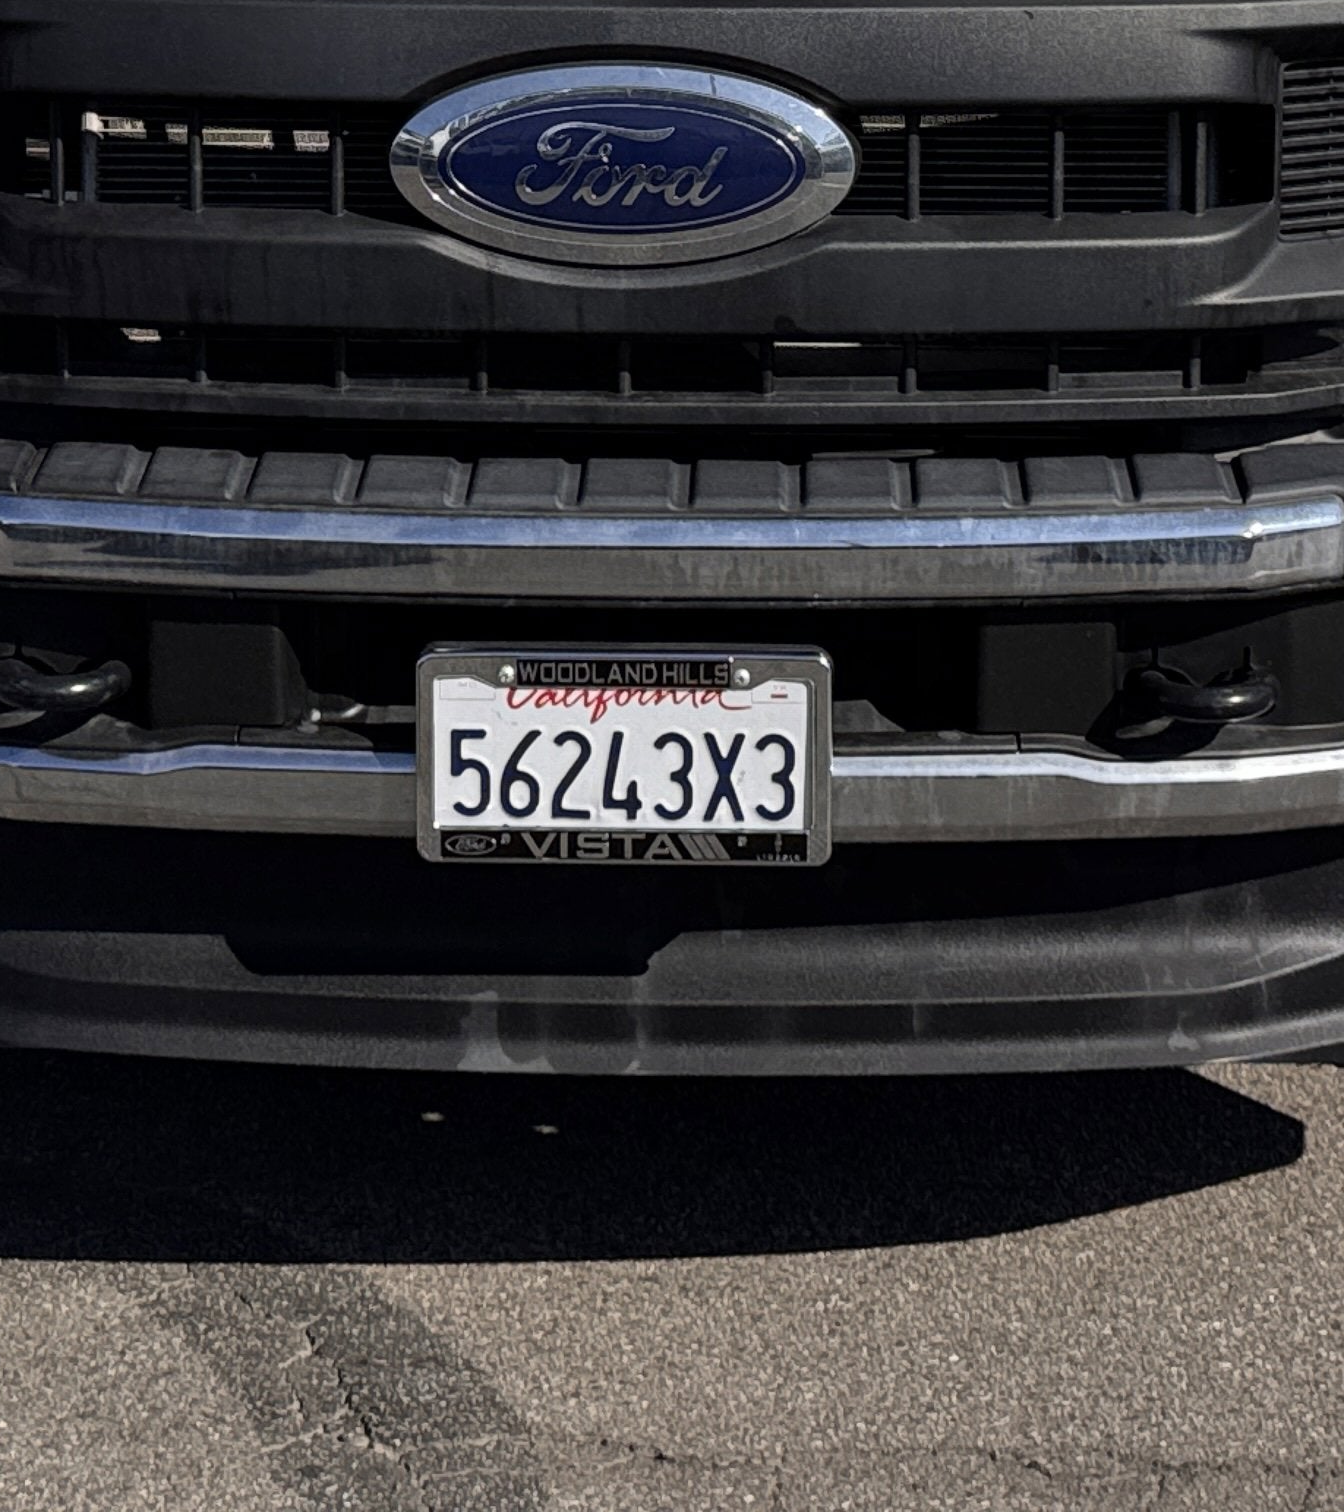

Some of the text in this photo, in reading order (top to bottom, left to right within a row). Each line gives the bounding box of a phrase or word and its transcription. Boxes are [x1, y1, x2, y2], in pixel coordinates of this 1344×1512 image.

[515, 120, 729, 208] Ford
[517, 661, 730, 686] WOODLAND HILLS
[449, 728, 797, 823] 56243X3
[520, 832, 684, 861] VISTA
